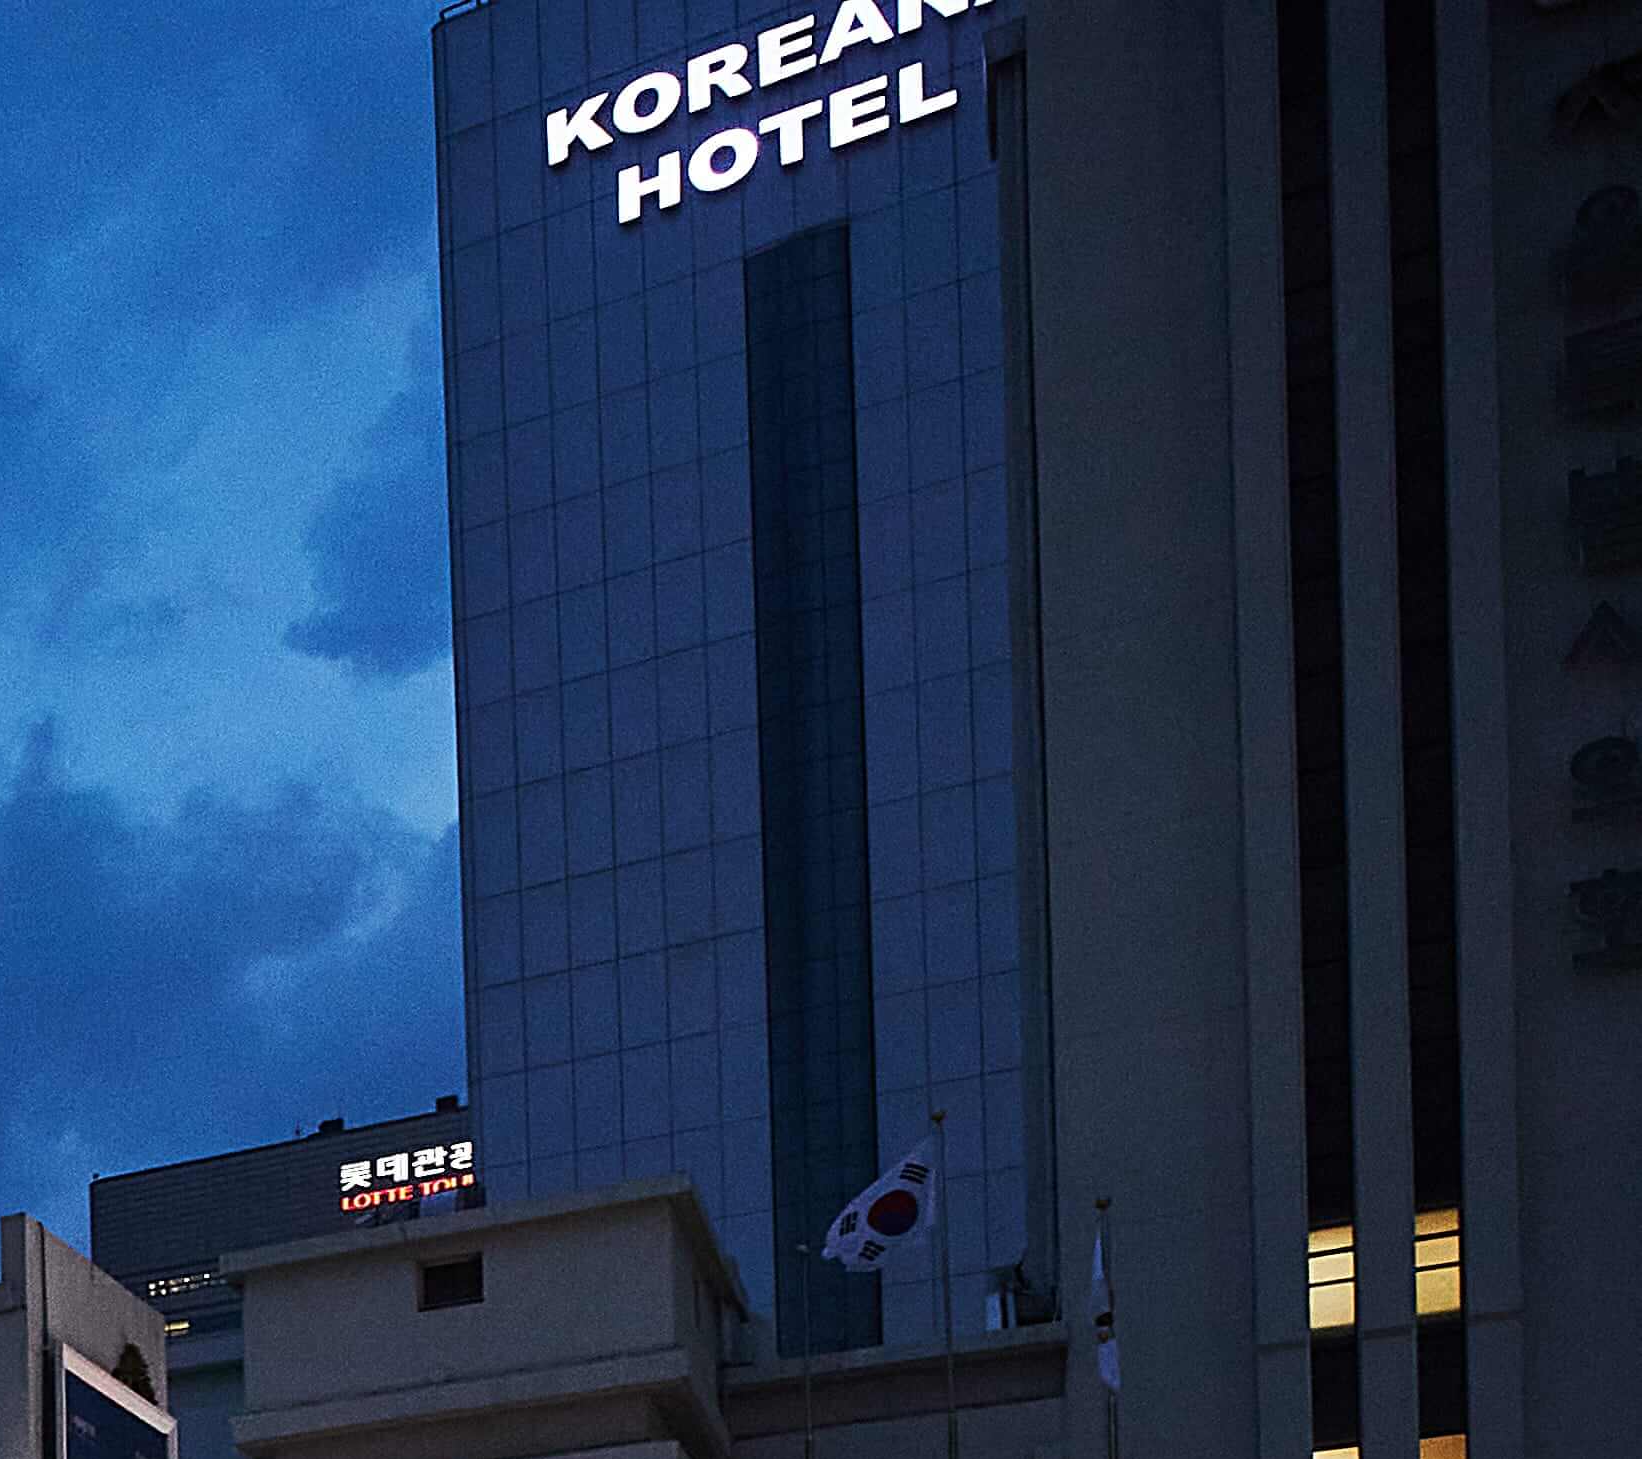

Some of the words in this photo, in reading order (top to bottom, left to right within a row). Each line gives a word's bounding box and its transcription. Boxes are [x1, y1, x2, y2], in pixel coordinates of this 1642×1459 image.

[546, 0, 994, 166] KOREAN
[616, 61, 958, 226] HOTEL
[340, 1184, 415, 1212] LOTTE
